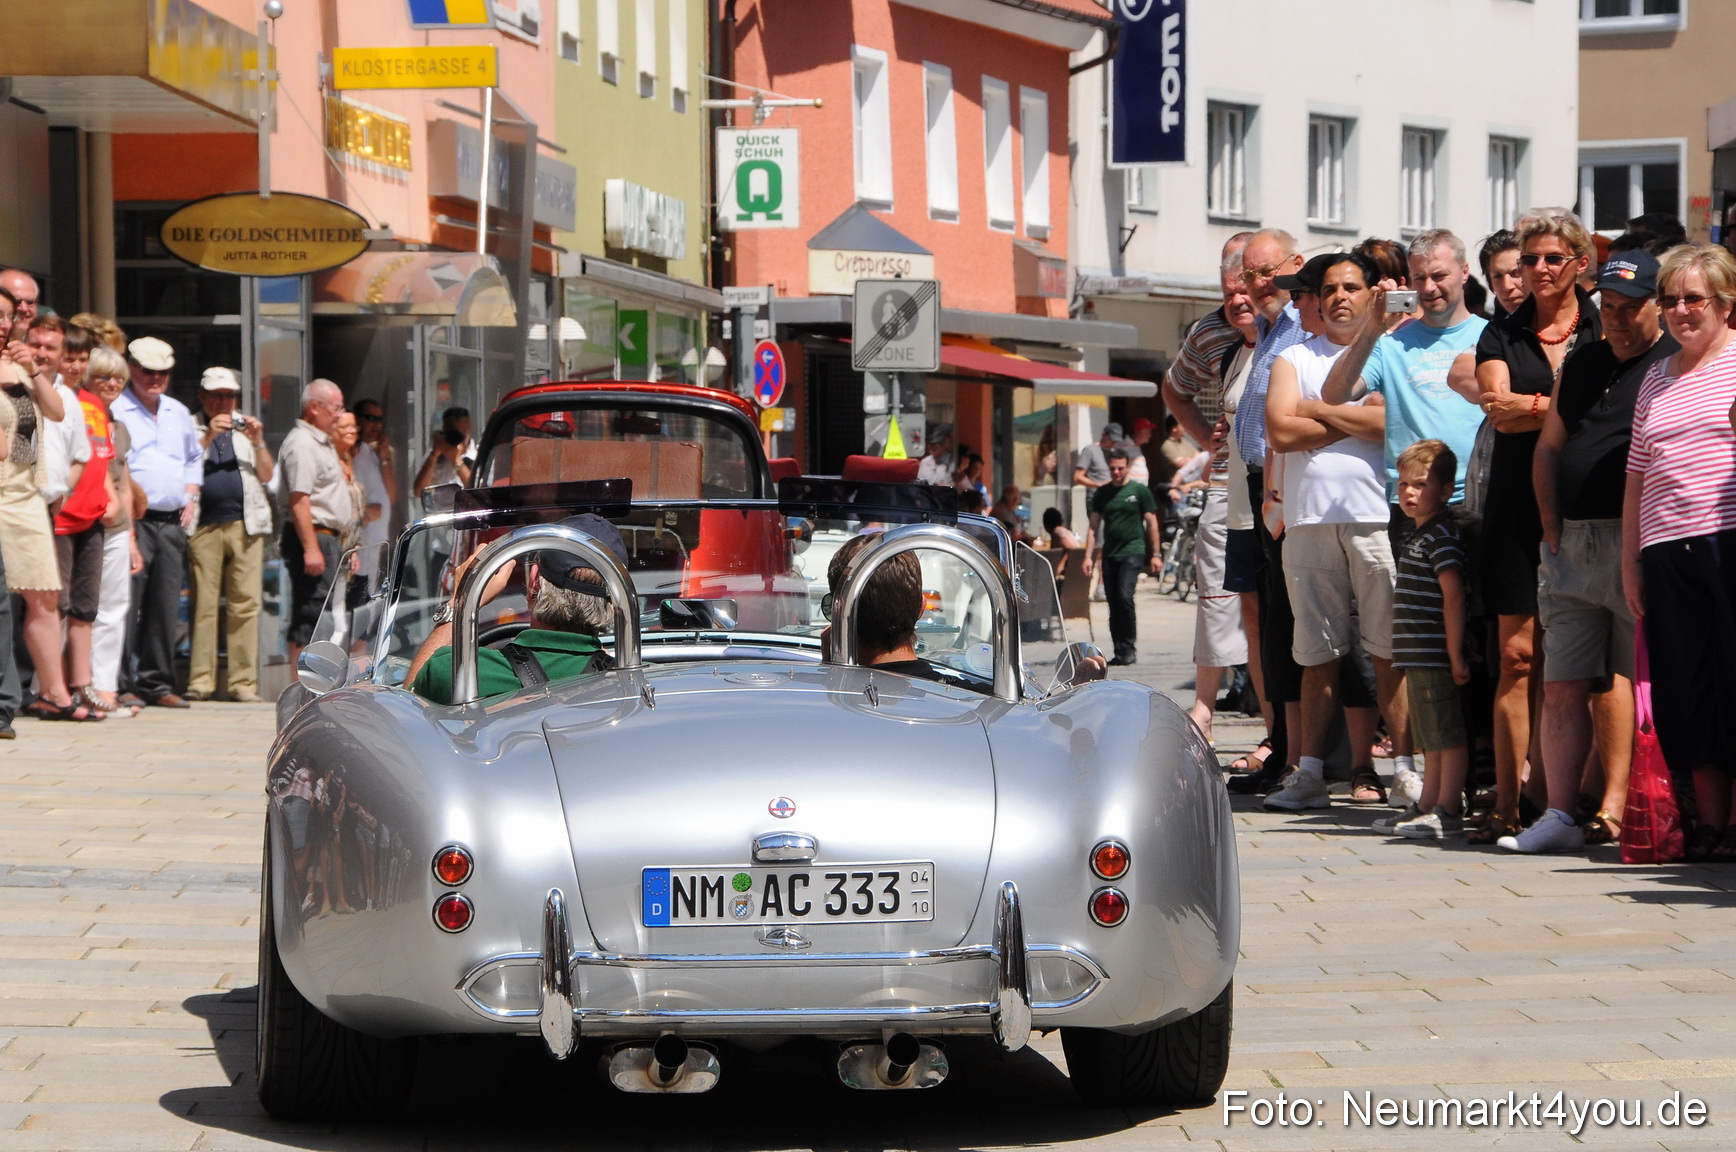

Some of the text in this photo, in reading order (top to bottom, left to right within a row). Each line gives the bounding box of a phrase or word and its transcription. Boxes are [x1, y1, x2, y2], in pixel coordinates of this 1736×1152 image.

[342, 58, 486, 76] KLOSTERGASSE 4
[736, 135, 780, 147] QUICK
[735, 147, 783, 158] SCHUH
[172, 227, 363, 242] DIE GOLDSCHMIEDE
[223, 251, 307, 261] JUTTA ROTHER
[834, 252, 911, 279] Creppresso
[911, 870, 929, 883] 04
[673, 871, 900, 918] NM AC 333
[652, 903, 662, 916] D
[912, 901, 929, 914] 10
